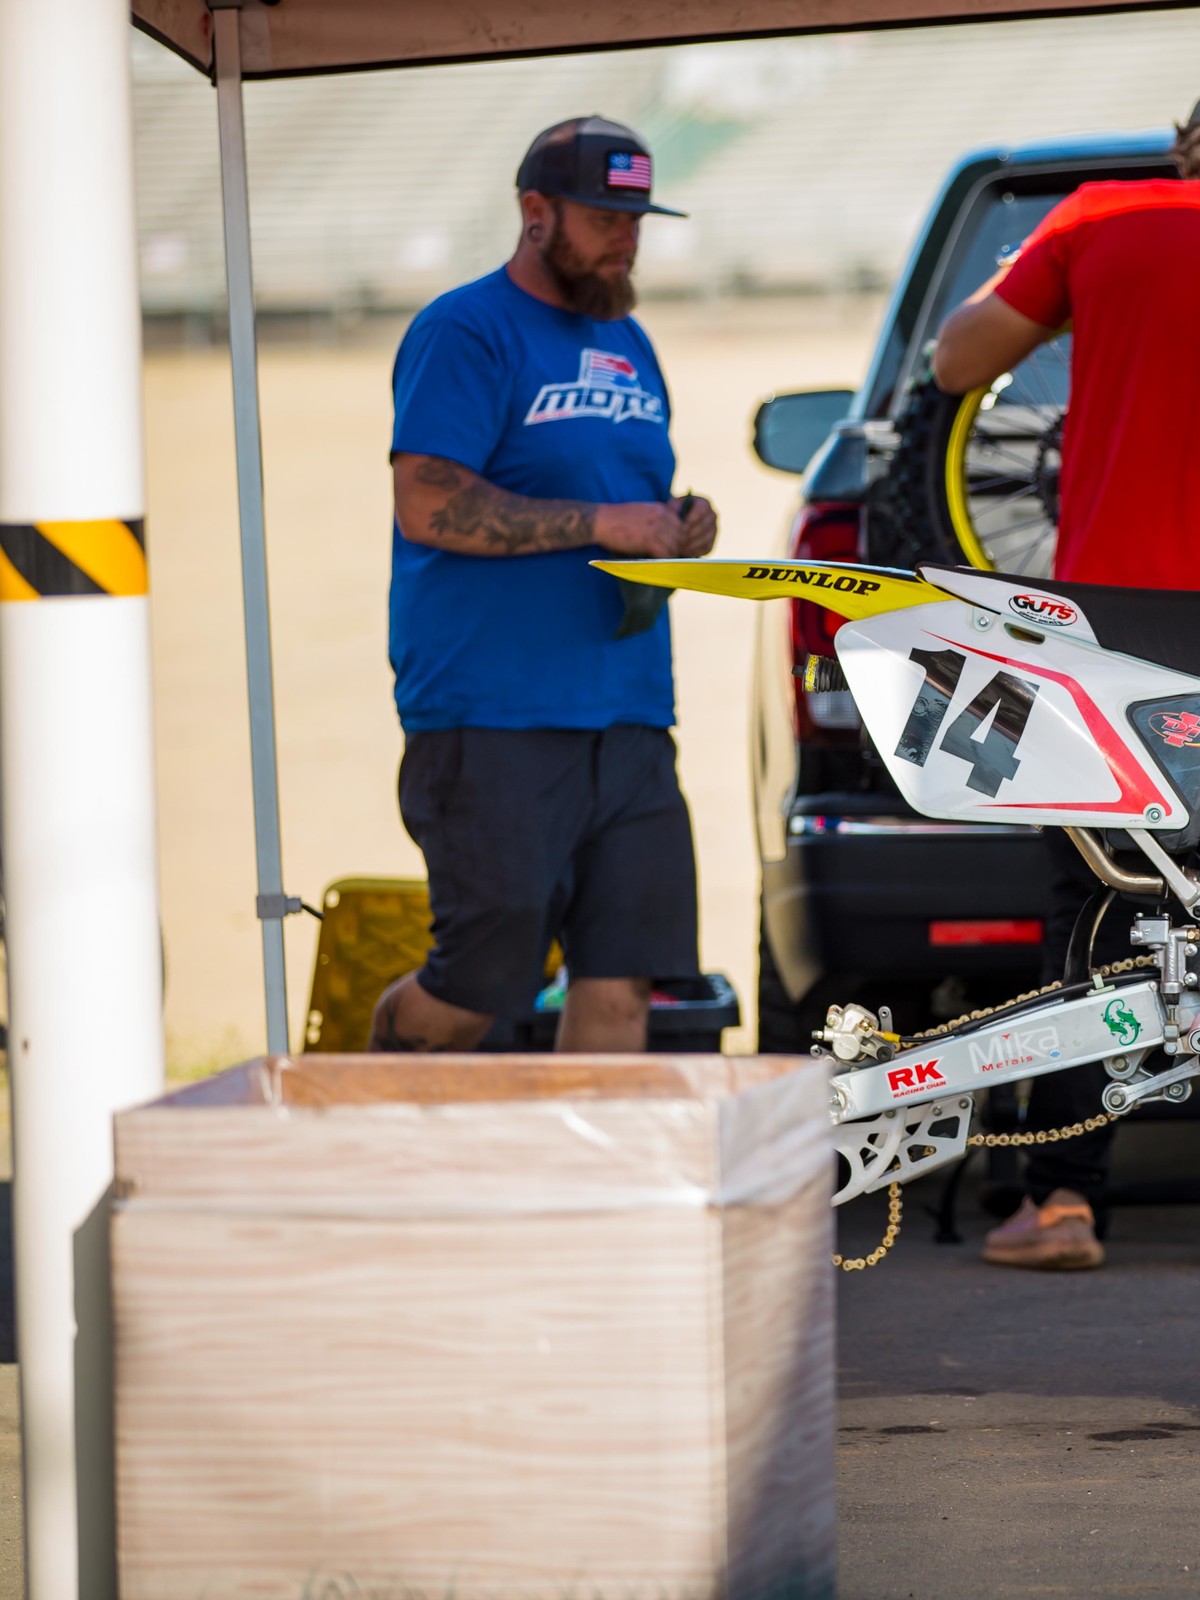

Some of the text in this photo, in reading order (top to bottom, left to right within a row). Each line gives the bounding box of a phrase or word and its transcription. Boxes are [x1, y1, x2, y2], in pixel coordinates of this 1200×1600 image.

[742, 566, 881, 596] DUNLOP
[1013, 594, 1075, 620] GUTS
[893, 646, 1040, 798] 14
[968, 1025, 1060, 1074] Mika
[981, 1055, 1034, 1073] Metals
[887, 1058, 945, 1092] RK
[893, 1080, 947, 1099] RACING CHAIN
